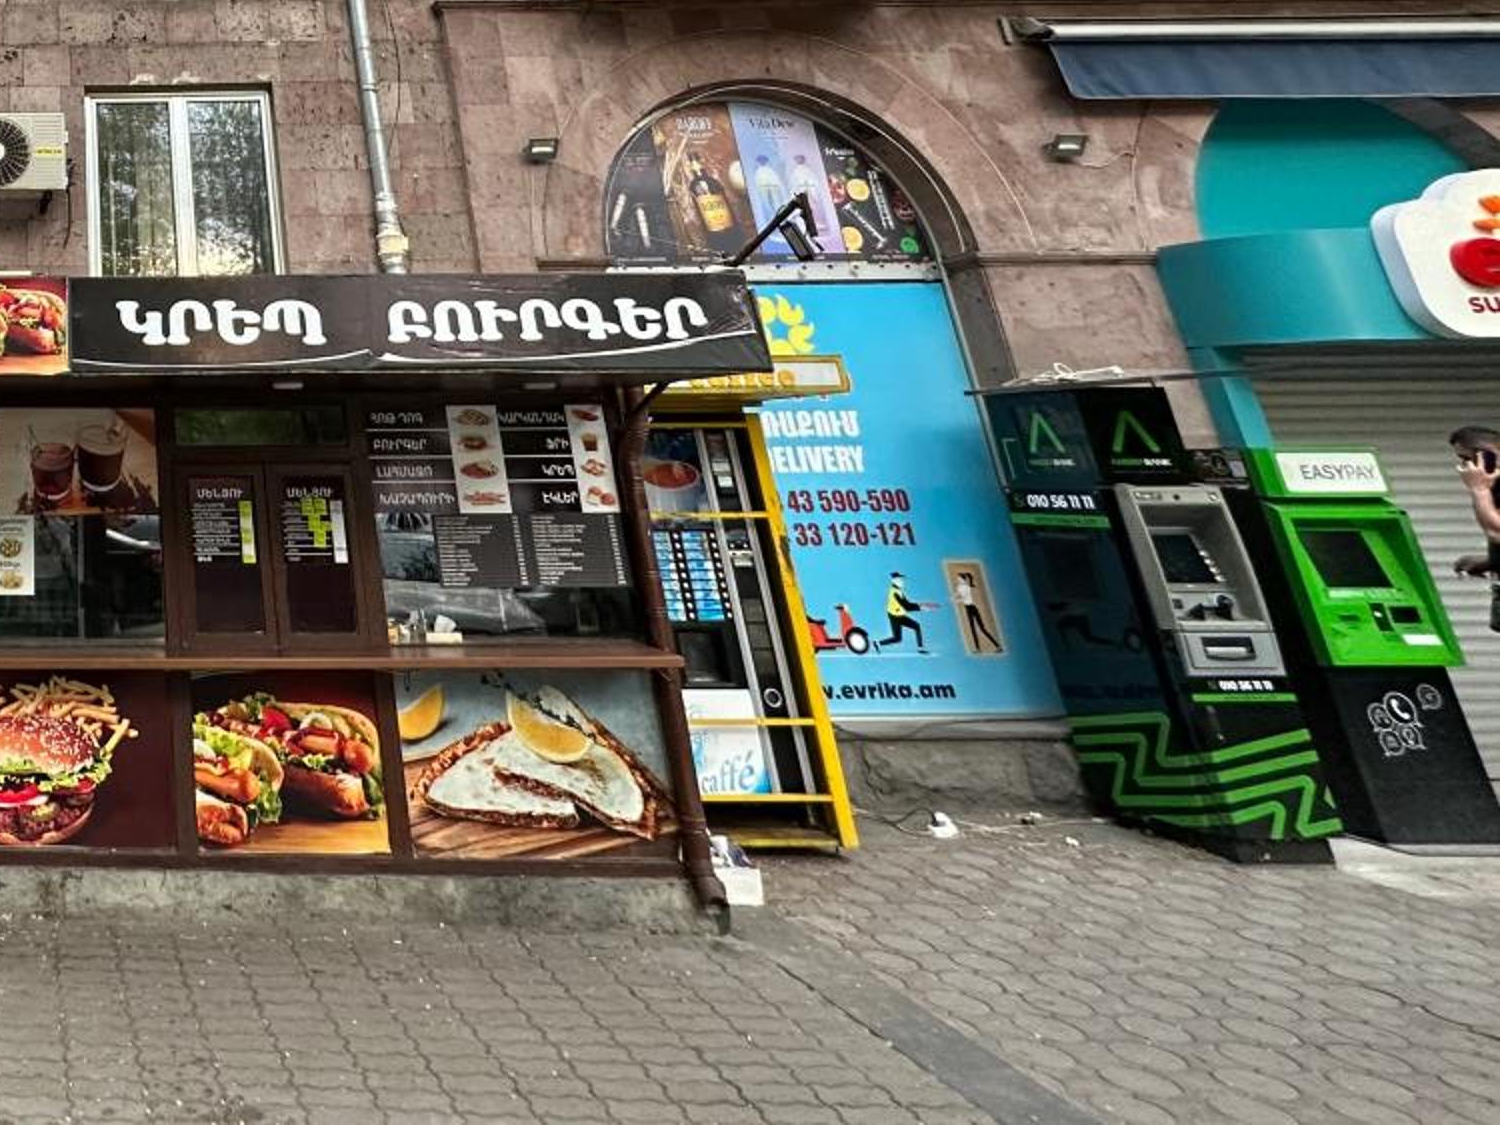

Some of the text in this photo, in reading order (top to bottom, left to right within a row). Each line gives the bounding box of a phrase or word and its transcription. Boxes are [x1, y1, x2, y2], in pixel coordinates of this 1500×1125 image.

[115, 297, 708, 346] ԿՐԵՊ ԲՈՒՐԳԵՐ
[760, 410, 860, 438] ՌԱՔՈՒՄ
[1299, 463, 1377, 481] EASYPAY
[787, 488, 911, 514] 43 590-590
[1026, 494, 1049, 509] 010
[1050, 494, 1068, 509] 56
[792, 522, 917, 546] 33 120-121
